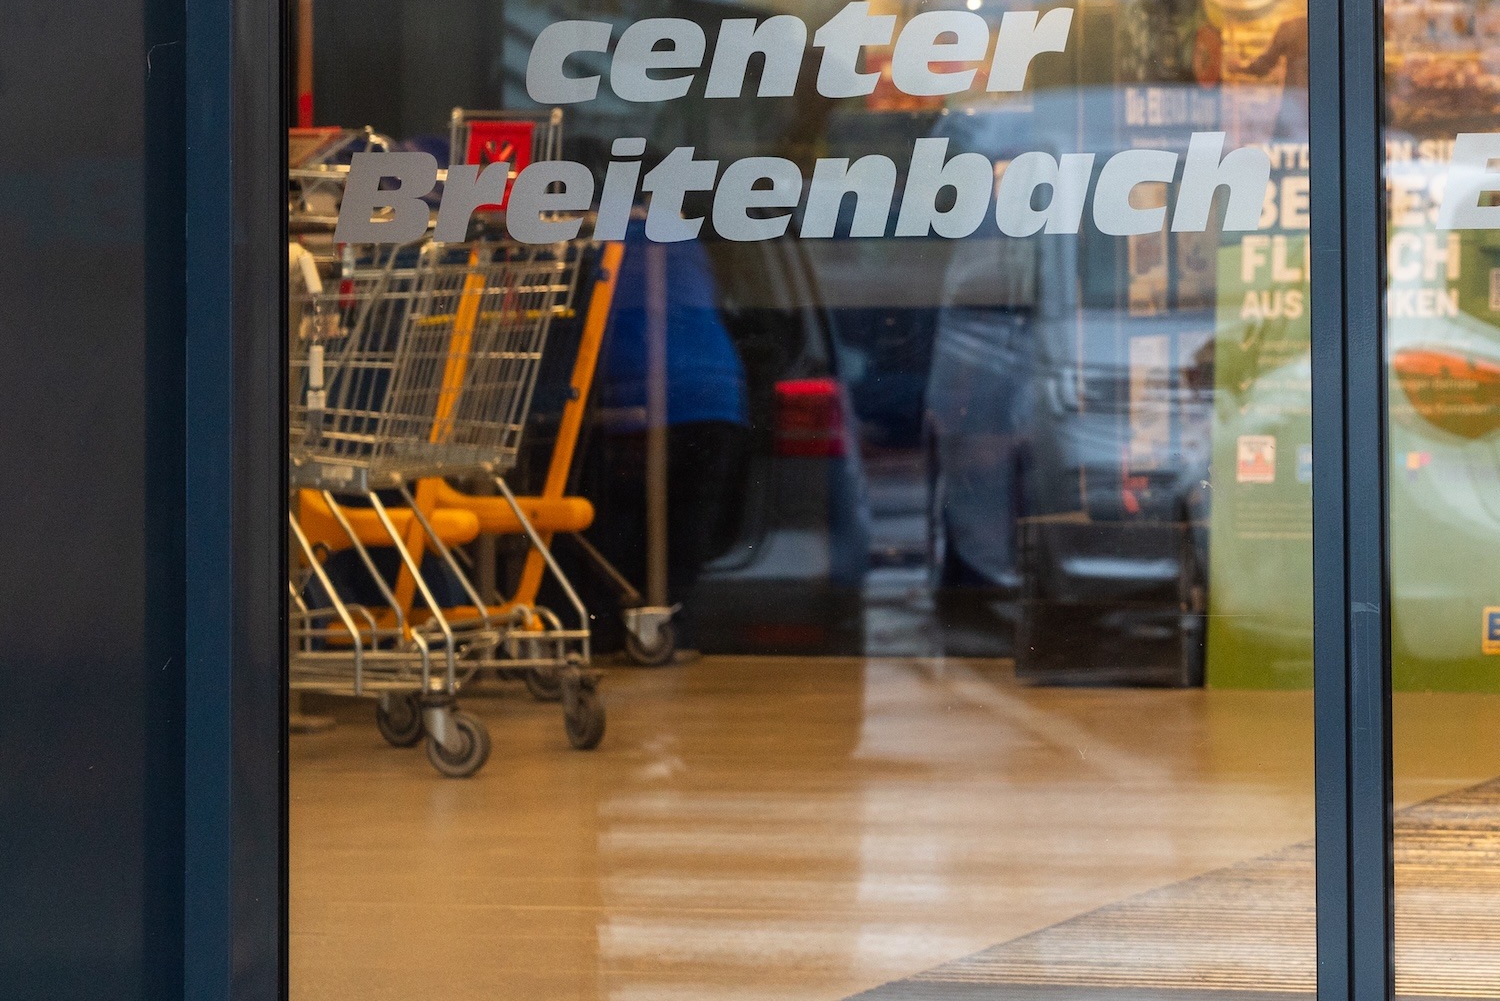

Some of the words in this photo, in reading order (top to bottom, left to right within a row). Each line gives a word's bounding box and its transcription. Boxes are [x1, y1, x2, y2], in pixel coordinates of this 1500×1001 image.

[526, 1, 1073, 103] center
[334, 131, 1271, 245] Breitenbach
[1240, 289, 1304, 320] AUS
